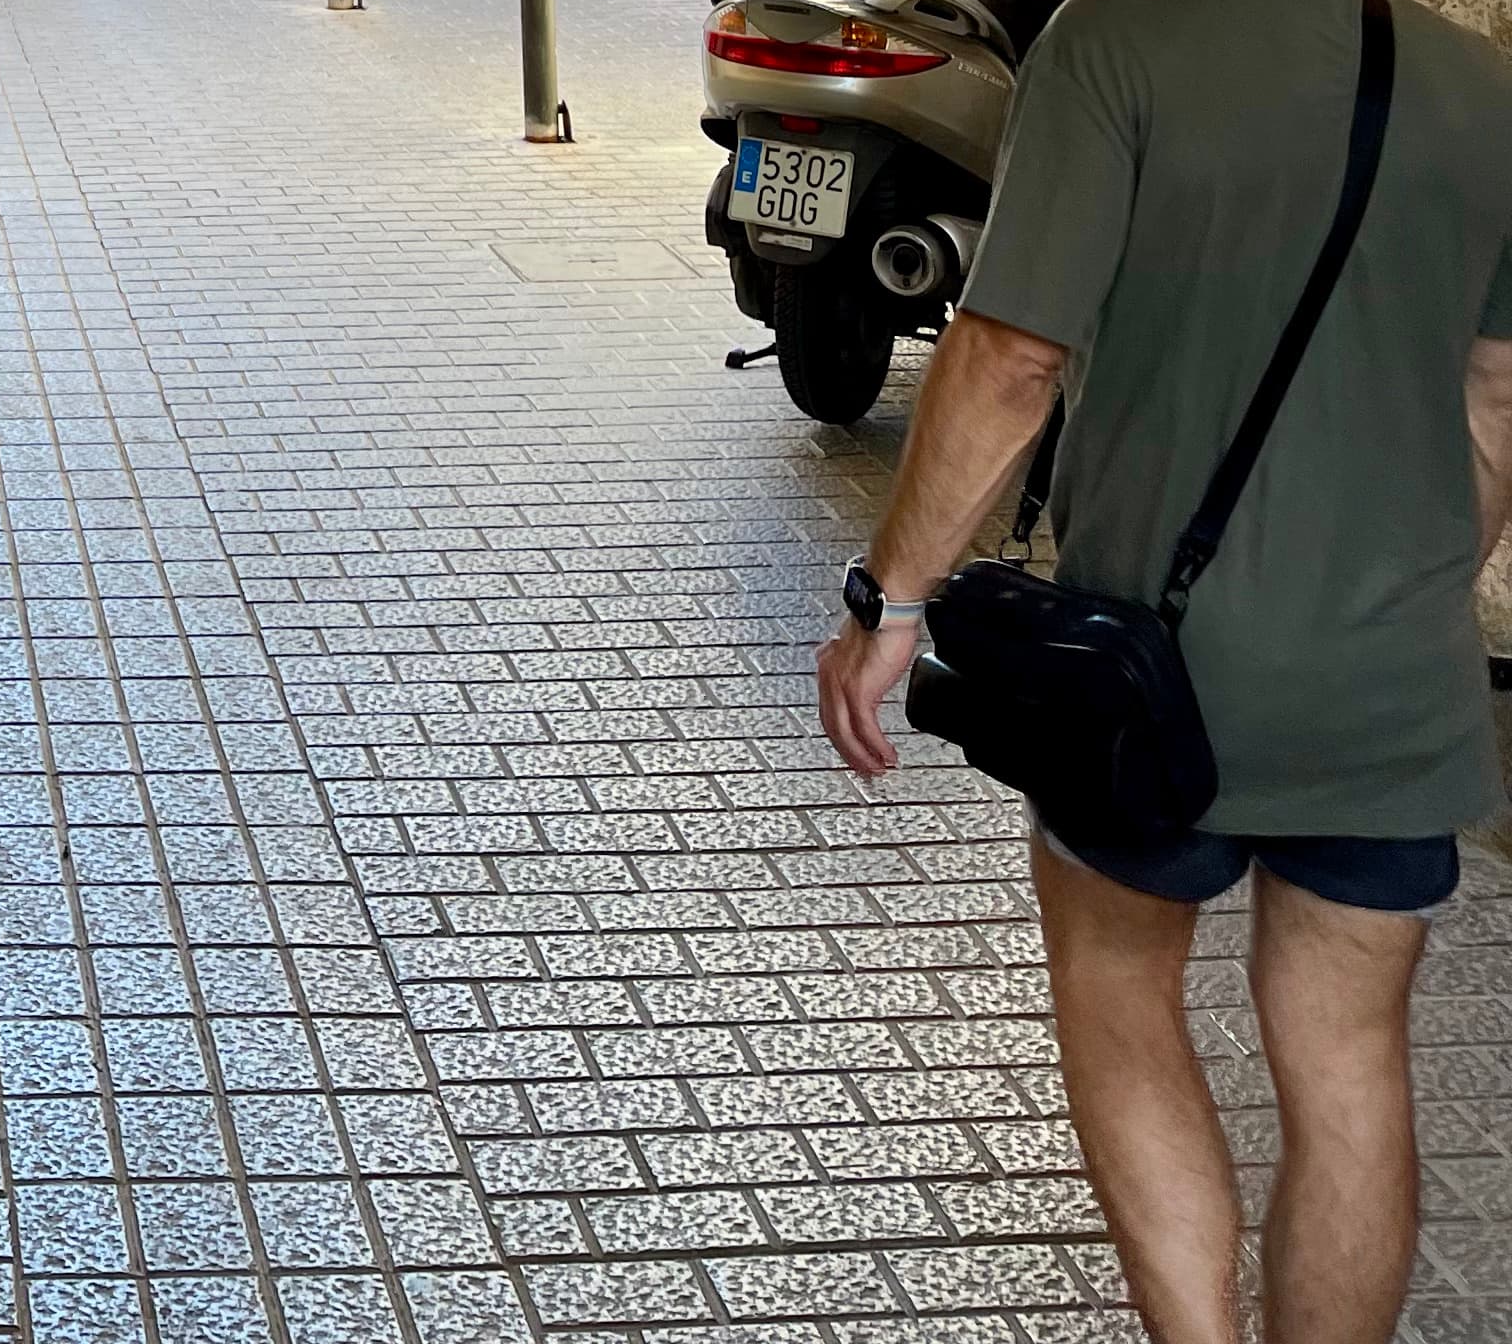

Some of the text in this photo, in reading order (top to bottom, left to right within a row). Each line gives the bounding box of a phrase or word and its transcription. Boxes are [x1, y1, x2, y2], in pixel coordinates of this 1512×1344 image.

[741, 170, 753, 184] E
[763, 146, 846, 192] 5302
[757, 185, 818, 225] GDG
